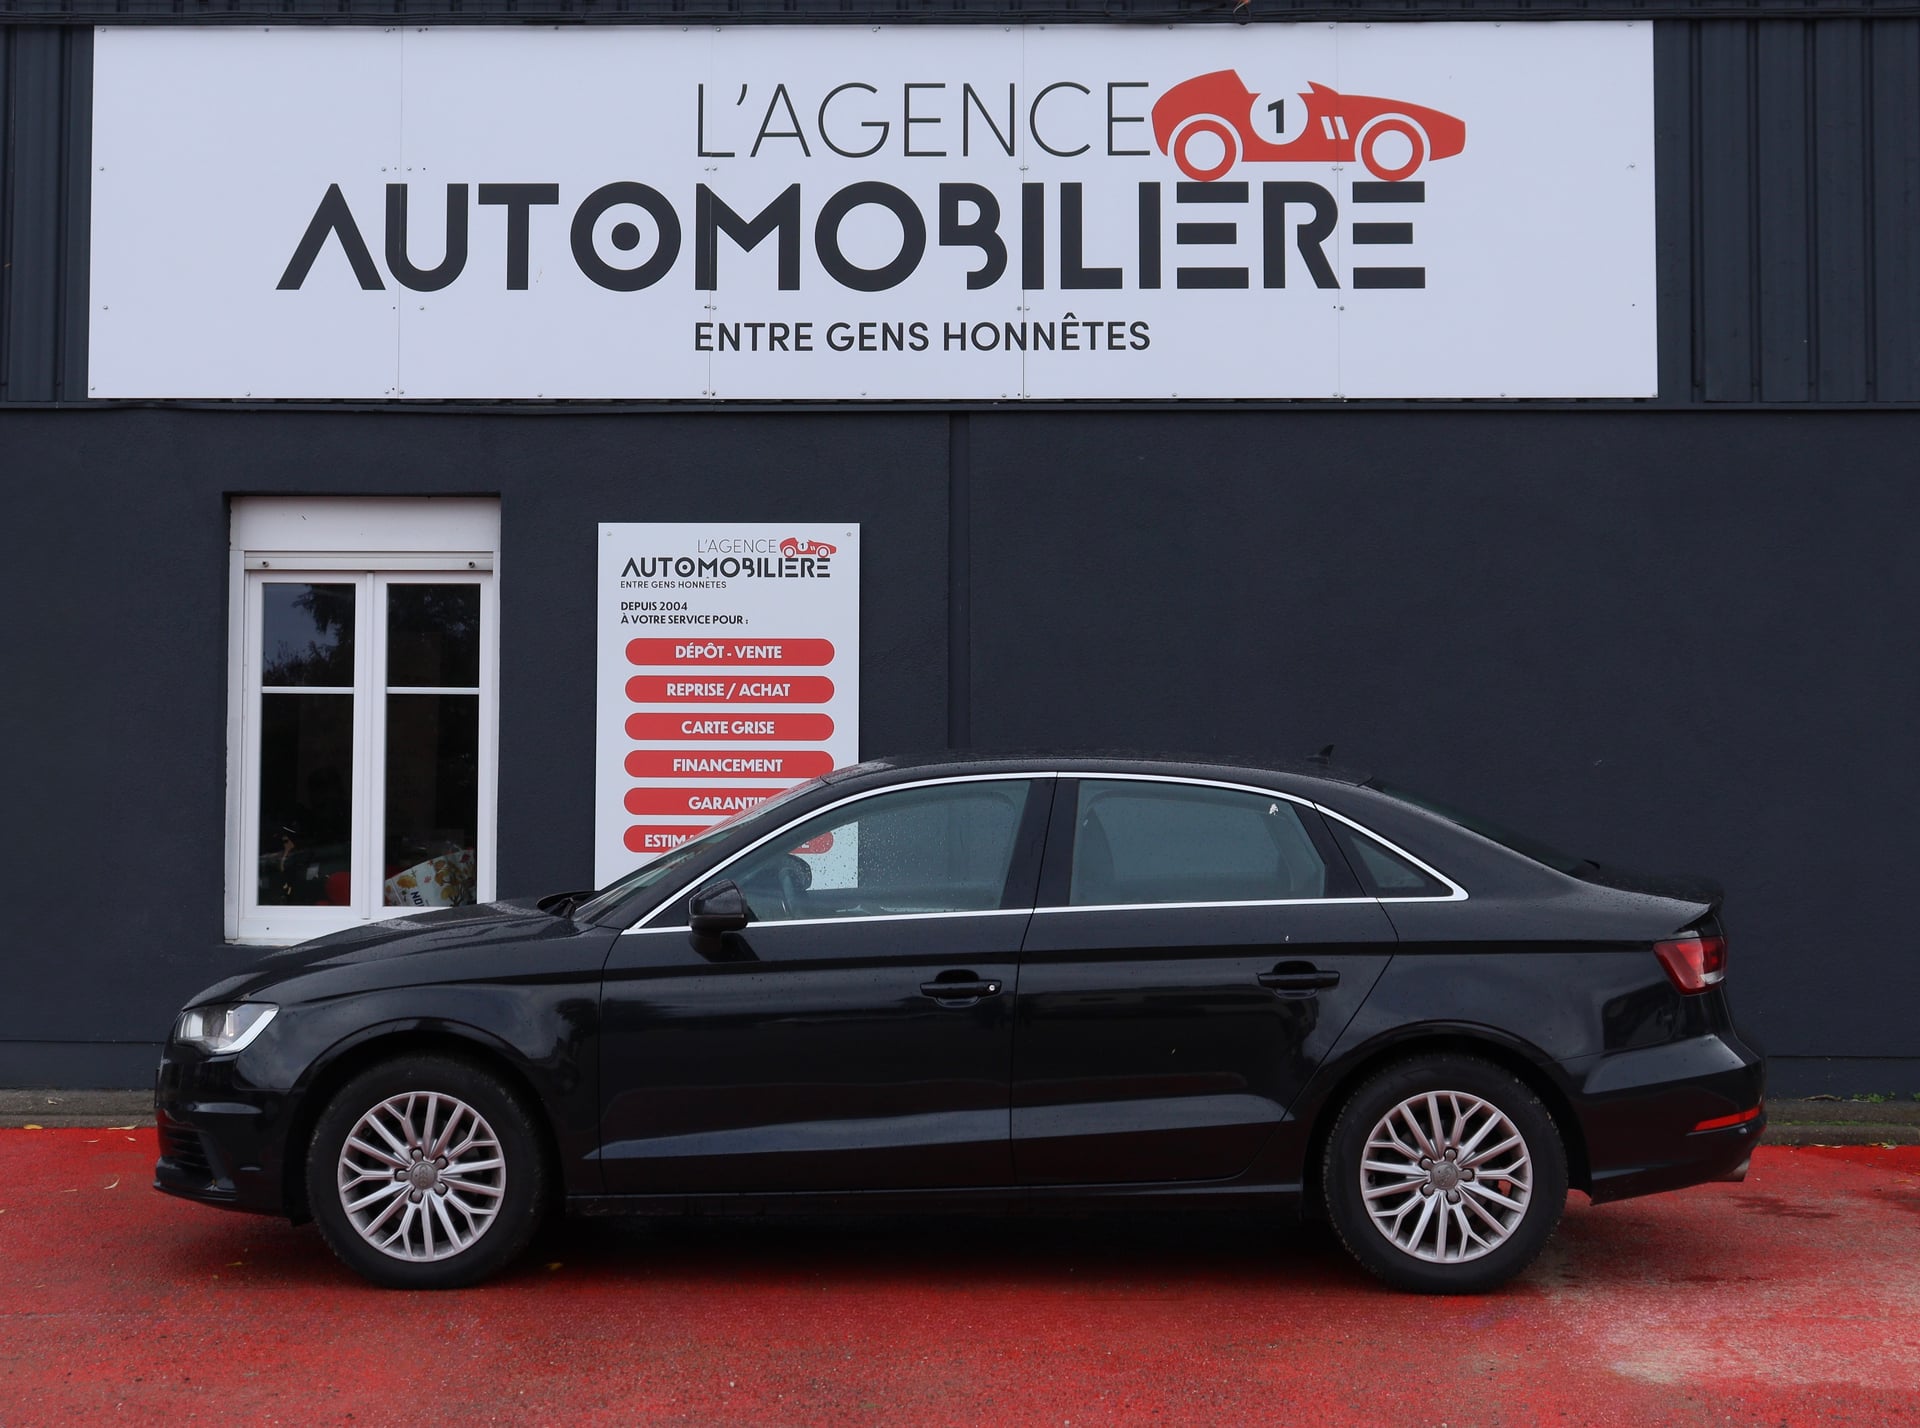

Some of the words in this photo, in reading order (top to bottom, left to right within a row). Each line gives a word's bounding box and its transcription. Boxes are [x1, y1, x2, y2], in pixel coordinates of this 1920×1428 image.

[697, 82, 1151, 158] L'AGENCE
[1266, 99, 1285, 134] 1
[275, 181, 1426, 292] AUTOMOBILIERE
[695, 322, 814, 352] ENTRE
[826, 322, 929, 352] GENS
[943, 312, 1151, 352] HONNÊTES
[697, 538, 777, 554] L'AGENCE
[620, 557, 831, 578] AUTOMOBILIERE
[620, 580, 649, 589] ENTRE
[651, 580, 676, 589] GENS
[678, 576, 727, 589] HONNÊTES
[620, 601, 658, 611] DEPUIS
[659, 601, 688, 611] 2004
[620, 613, 630, 625] À
[631, 615, 666, 625] VOTRE
[667, 615, 711, 625] SERVICE
[675, 642, 725, 659] DÉPÔT
[734, 645, 782, 659] VENTE
[666, 683, 725, 697] REPRISE
[738, 683, 791, 697] ACHAT
[681, 720, 729, 735] CARTE
[731, 720, 775, 735] GRISE
[673, 758, 783, 773] FINANCEMENT
[644, 834, 695, 848] ESTIM
